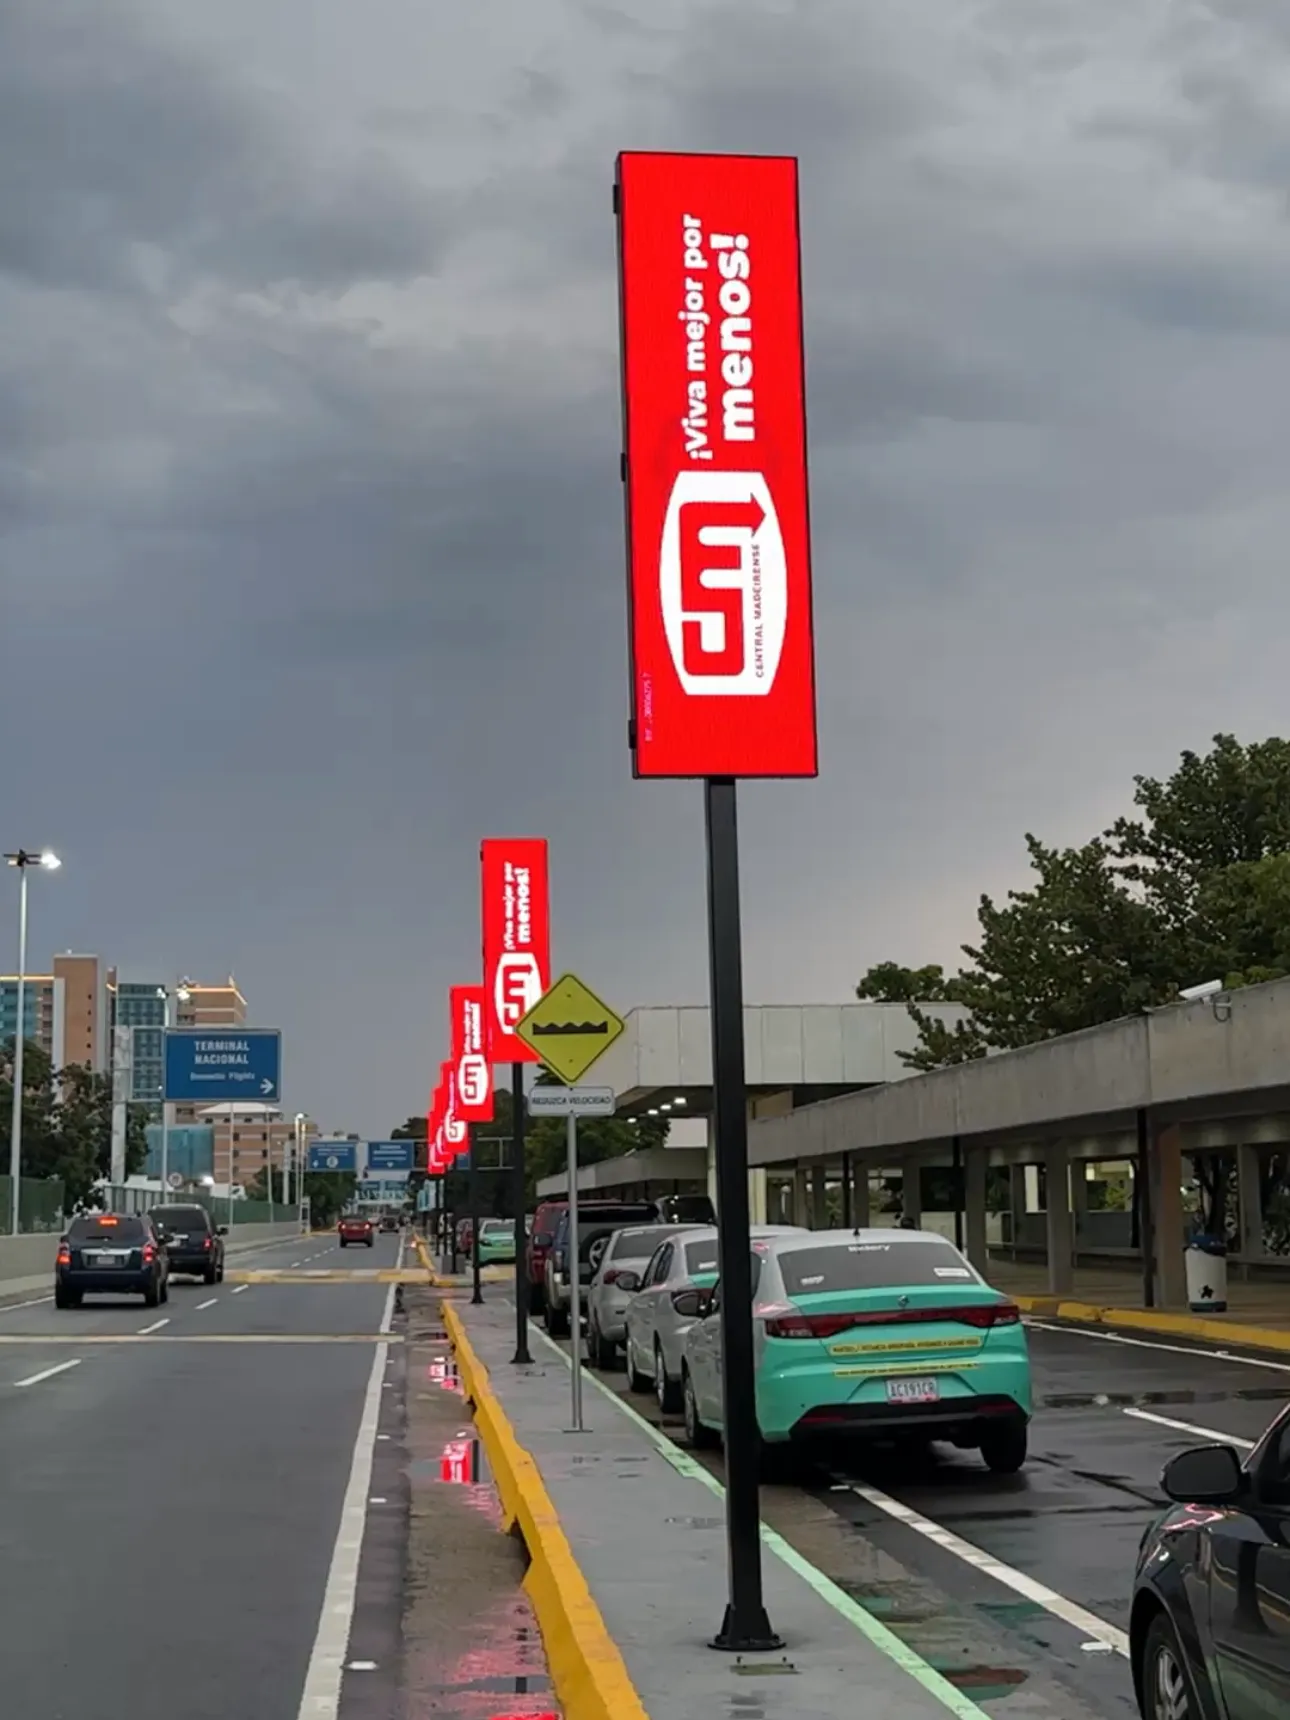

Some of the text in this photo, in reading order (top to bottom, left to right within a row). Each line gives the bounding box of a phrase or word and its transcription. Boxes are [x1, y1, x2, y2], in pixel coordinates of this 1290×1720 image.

[678, 214, 713, 460] ¡Viva mejor por
[709, 233, 755, 441] menos!
[751, 544, 765, 678] CENTRAL MADEIRENSE
[194, 1040, 250, 1052] TERMINAL
[194, 1053, 249, 1065] NACIONAL
